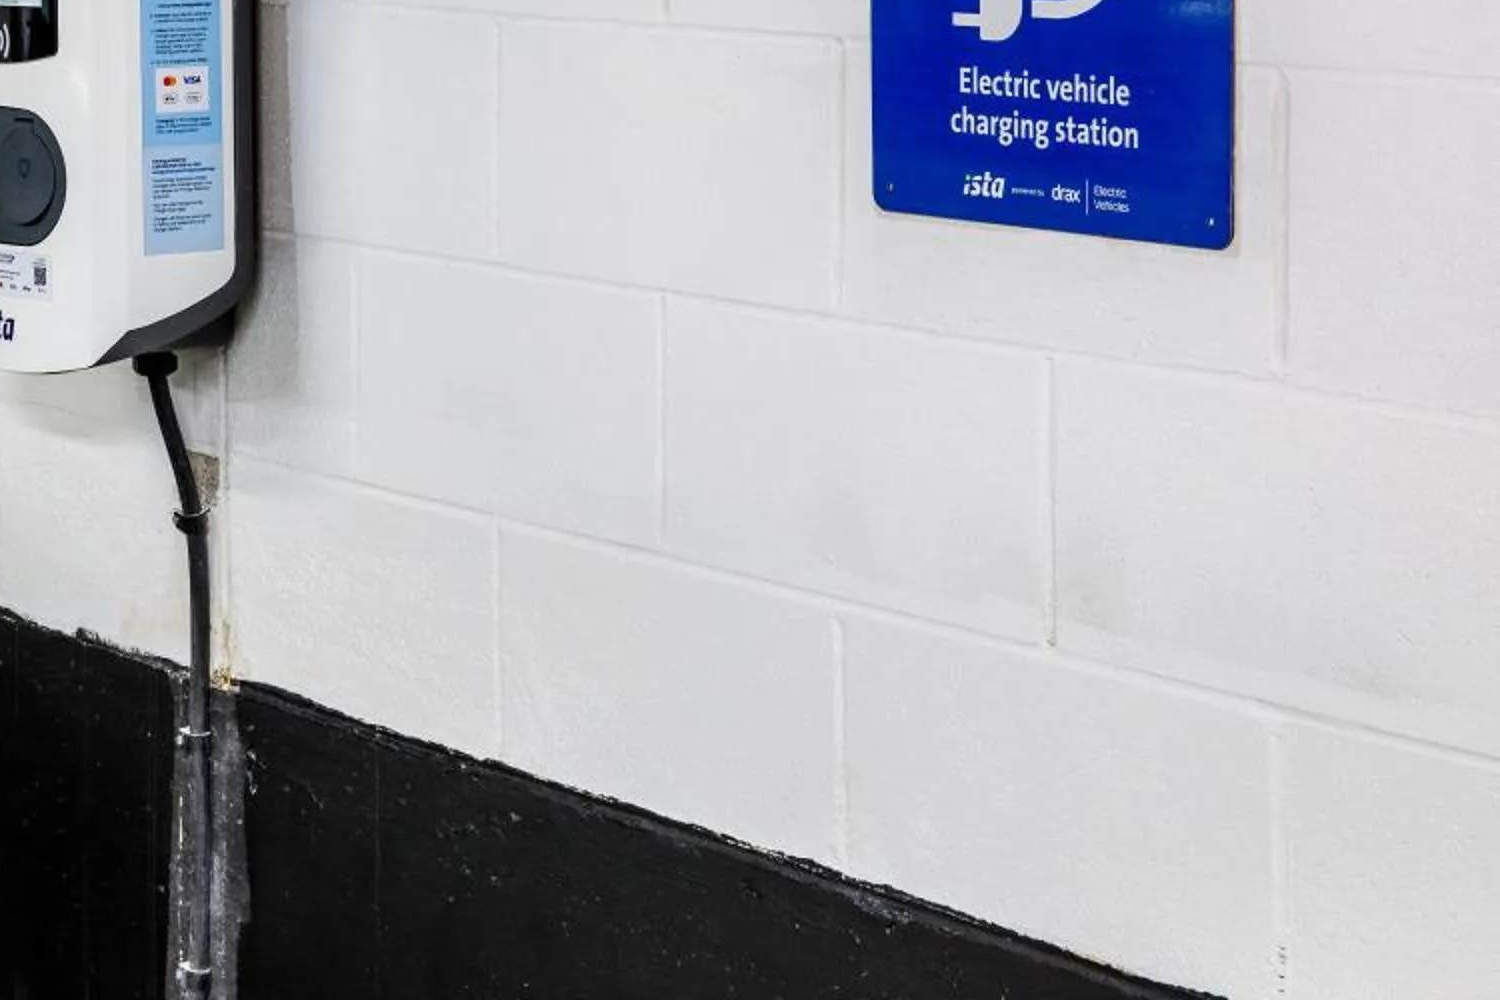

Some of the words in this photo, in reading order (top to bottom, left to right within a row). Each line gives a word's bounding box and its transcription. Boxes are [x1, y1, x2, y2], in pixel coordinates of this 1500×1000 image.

[958, 65, 1042, 100] Electric
[1046, 73, 1132, 107] vehicle
[950, 105, 1050, 150] charging
[1055, 115, 1140, 150] station
[963, 171, 1006, 199] ista
[1051, 183, 1081, 203] drax
[1093, 184, 1128, 199] Electric
[1093, 199, 1131, 213] Vehicles
